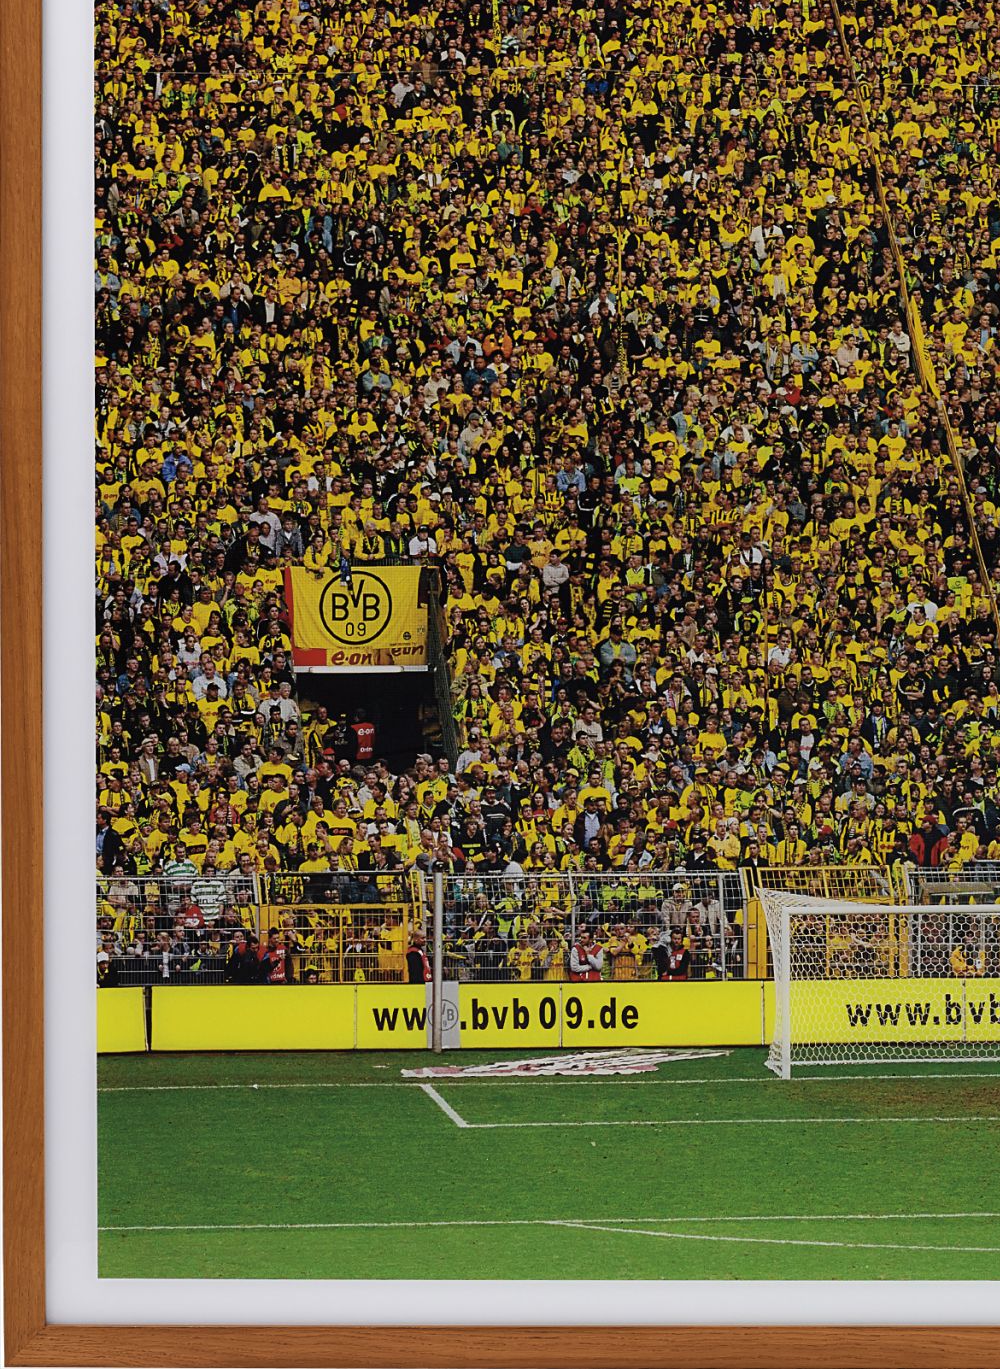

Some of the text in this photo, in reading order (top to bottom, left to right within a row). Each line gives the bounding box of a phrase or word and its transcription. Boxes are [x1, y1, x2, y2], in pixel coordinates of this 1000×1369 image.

[332, 579, 380, 621] BVB
[345, 622, 366, 637] 09
[372, 996, 639, 1032] ww.bvb09.de
